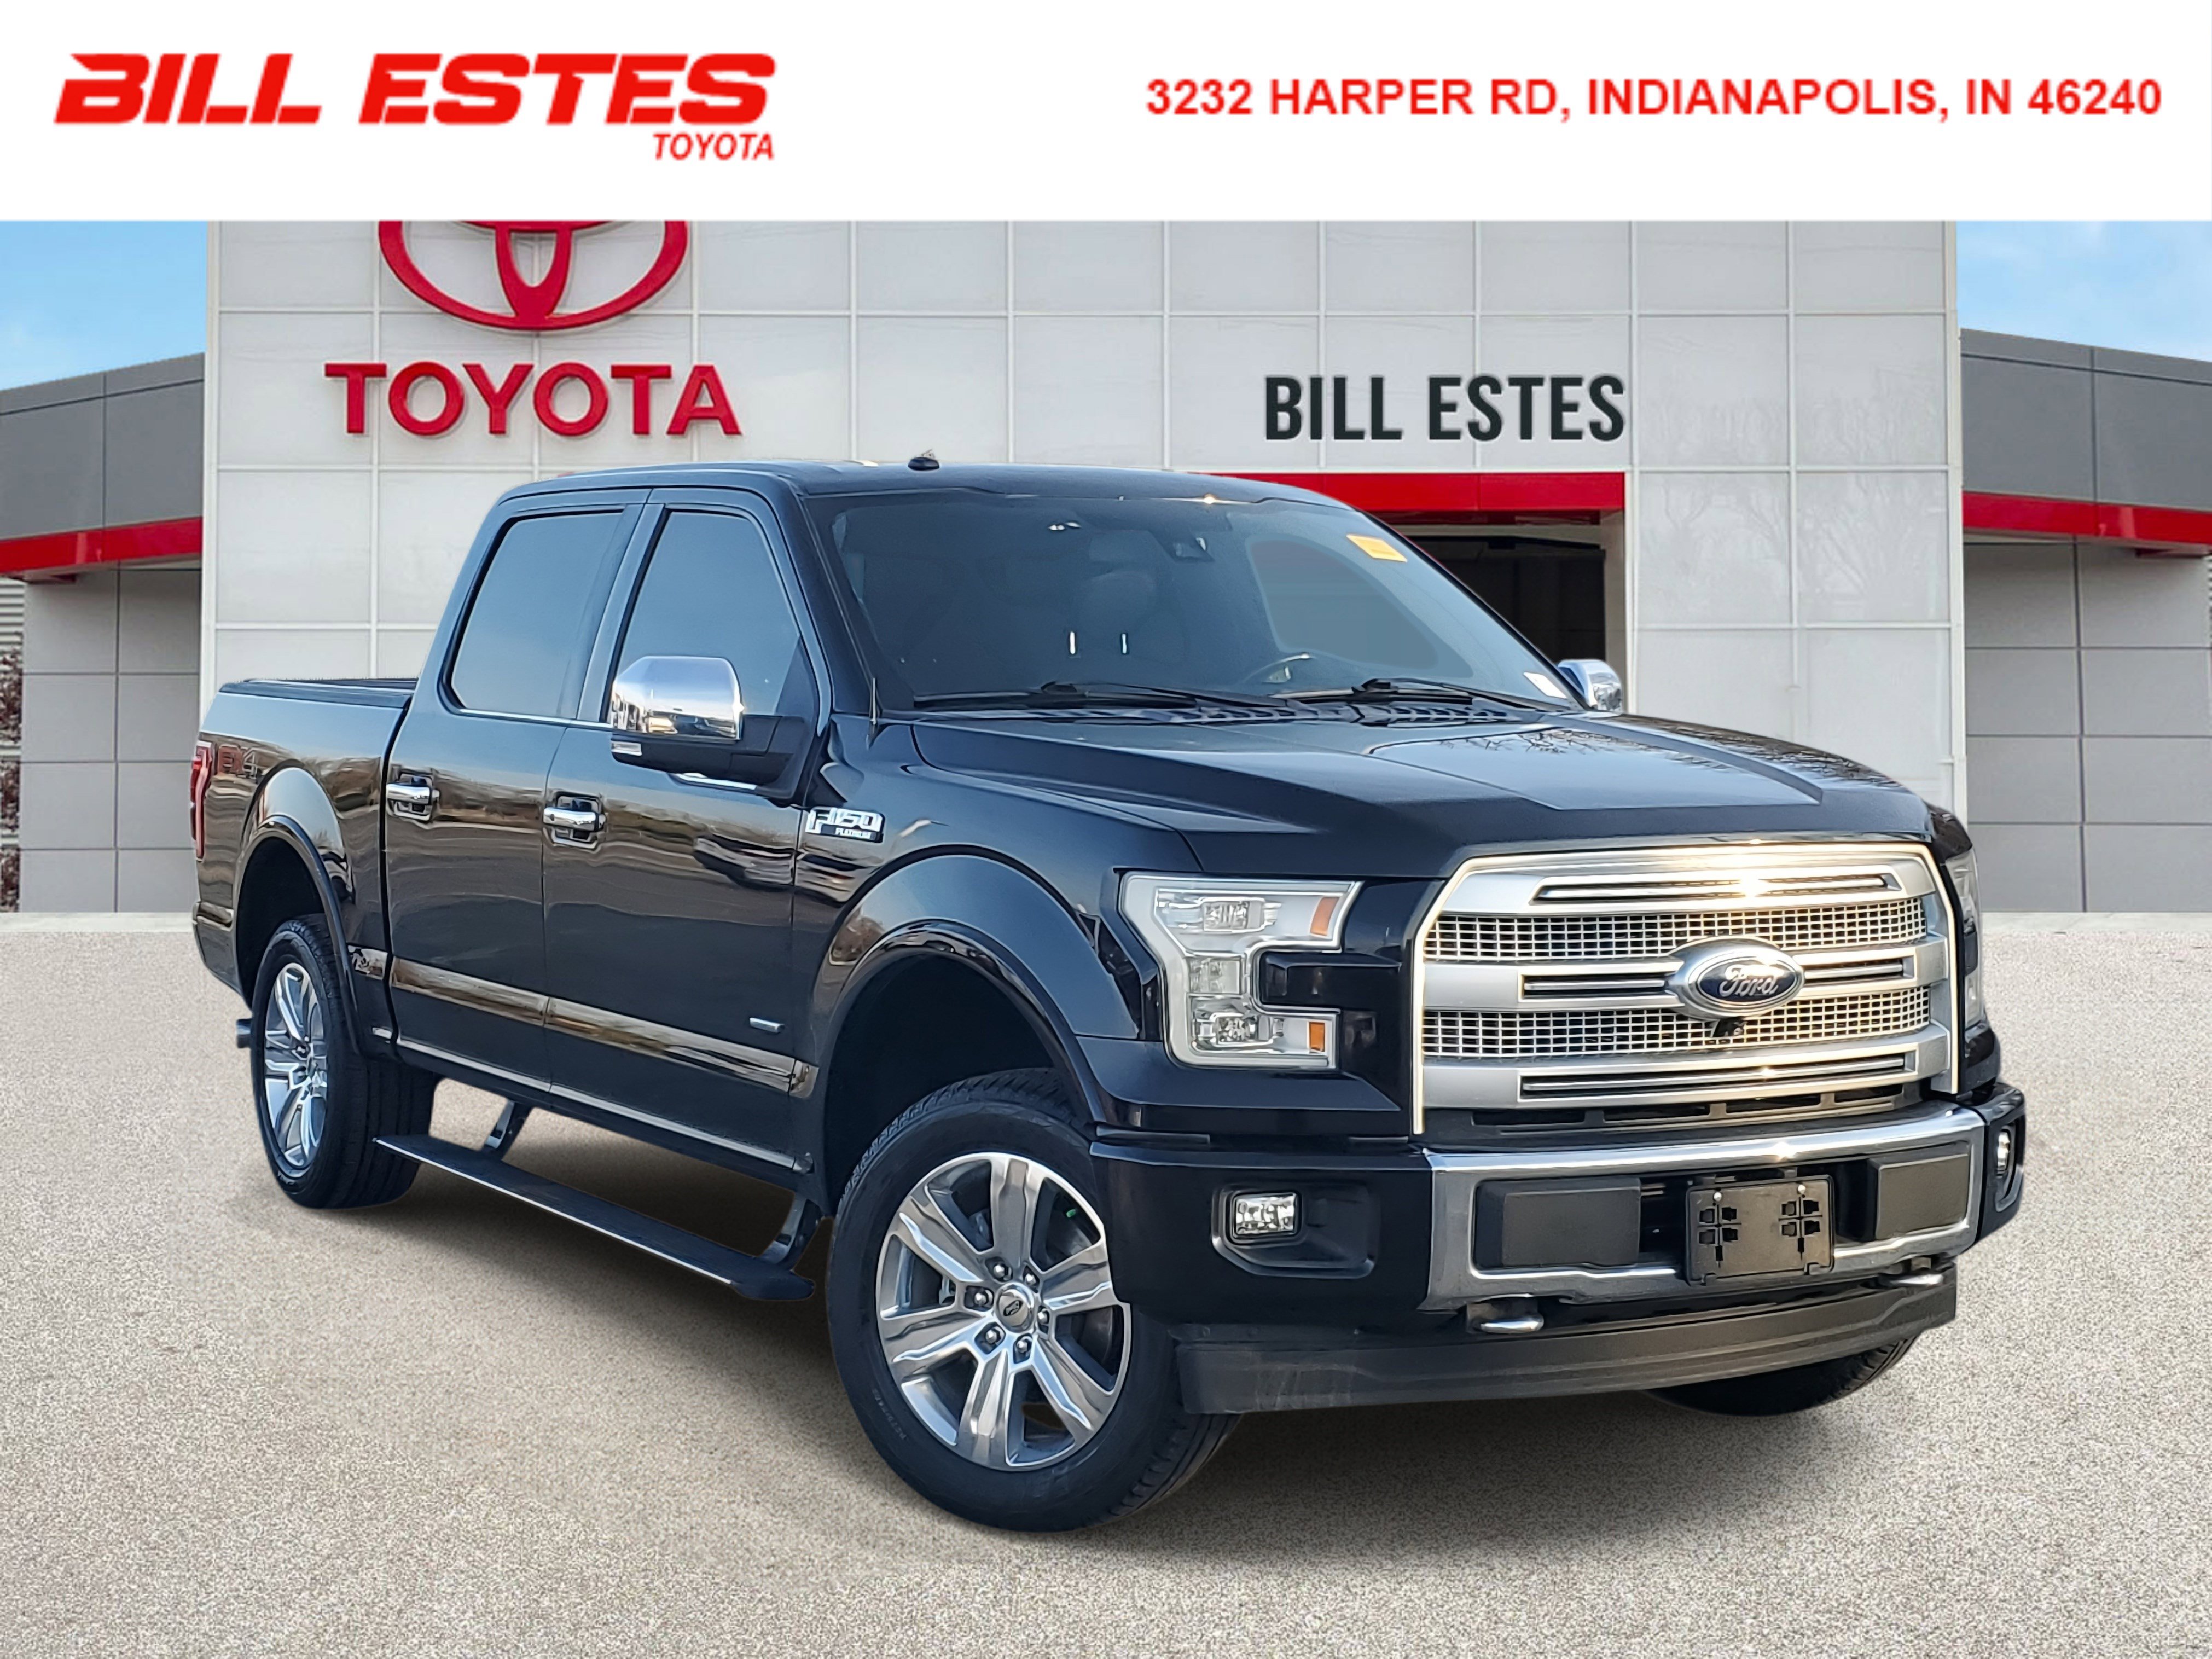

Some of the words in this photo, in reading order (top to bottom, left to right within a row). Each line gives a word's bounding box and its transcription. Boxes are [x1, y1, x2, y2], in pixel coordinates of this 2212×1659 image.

[325, 361, 741, 436] TOYOTA
[1265, 375, 1402, 440] BILL
[1429, 375, 1624, 441] ESTES
[1719, 964, 1784, 997] Ford
